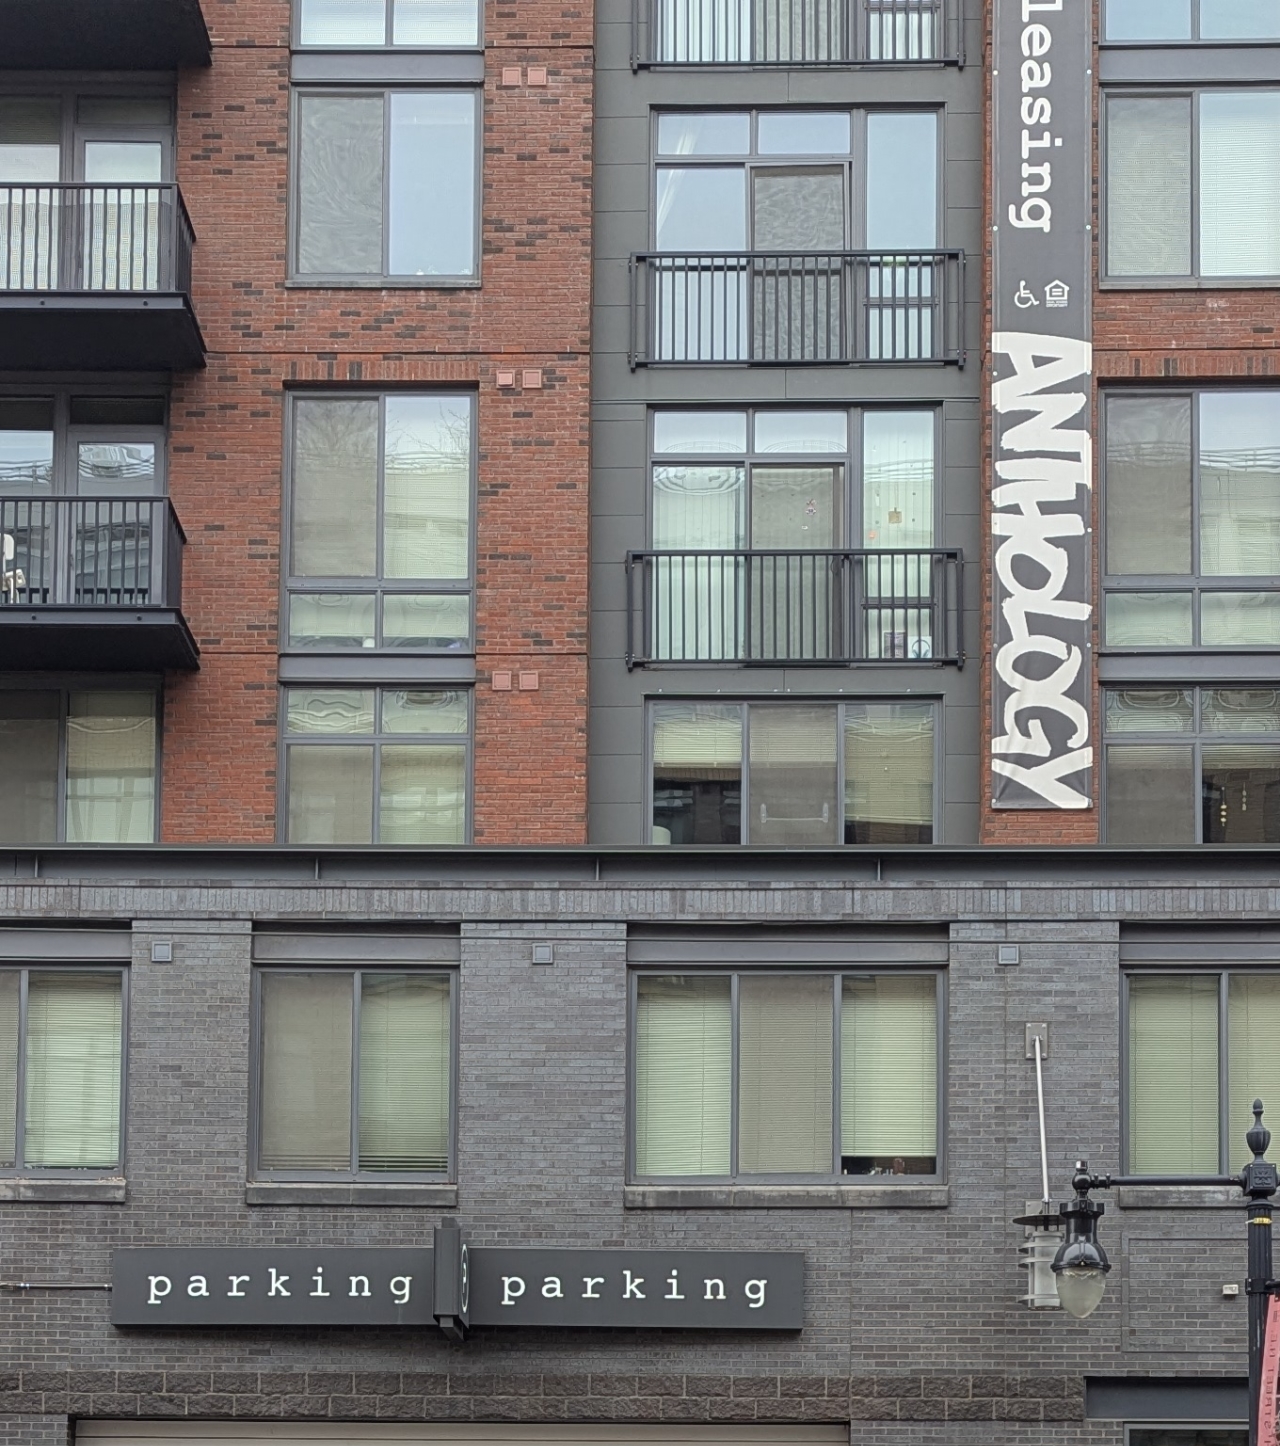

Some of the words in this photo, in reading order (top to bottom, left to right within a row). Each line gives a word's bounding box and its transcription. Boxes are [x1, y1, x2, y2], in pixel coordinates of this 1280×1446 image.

[992, 332, 1093, 809] ANTHOLOGY
[146, 1267, 414, 1304] parking
[500, 1269, 769, 1309] parking
